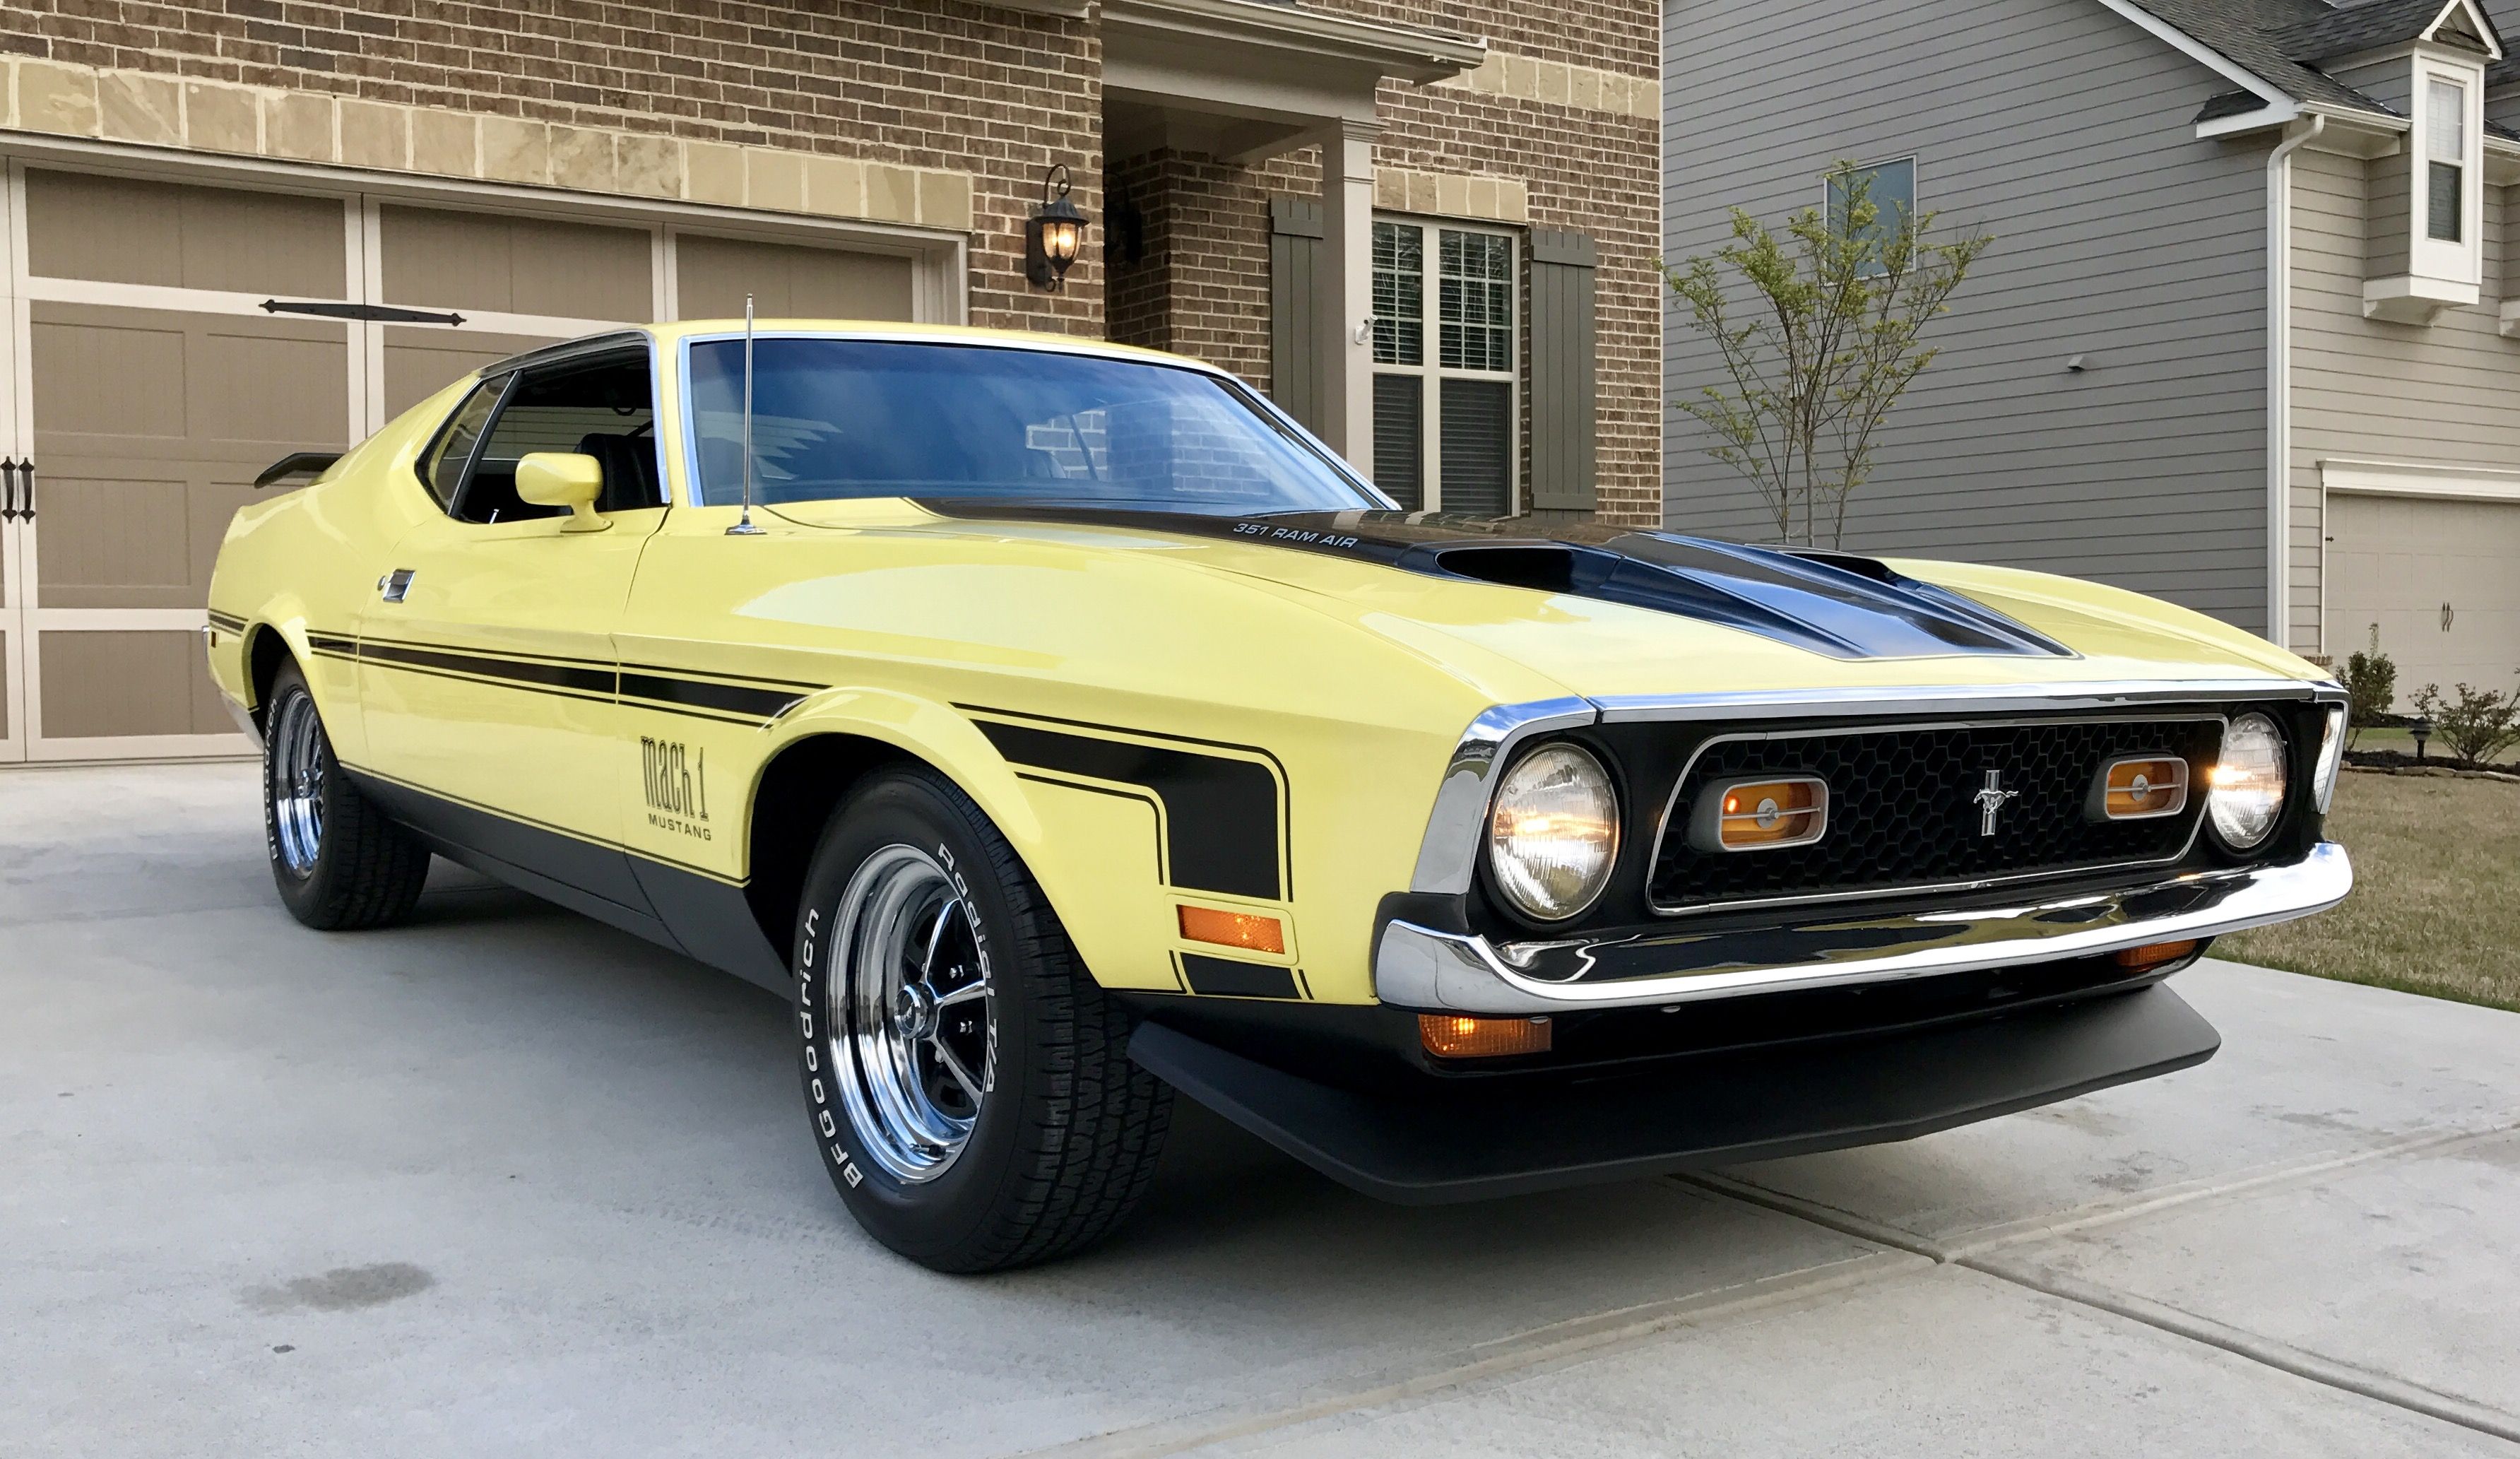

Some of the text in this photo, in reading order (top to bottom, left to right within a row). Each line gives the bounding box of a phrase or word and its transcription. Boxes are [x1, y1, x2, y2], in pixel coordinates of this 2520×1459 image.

[1233, 523, 1359, 548] 351 RAM AIR
[697, 747, 709, 822] 1
[649, 813, 711, 841] MUSTANG
[938, 843, 998, 1092] Radial T/A
[800, 909, 864, 1188] BFGoodrich
